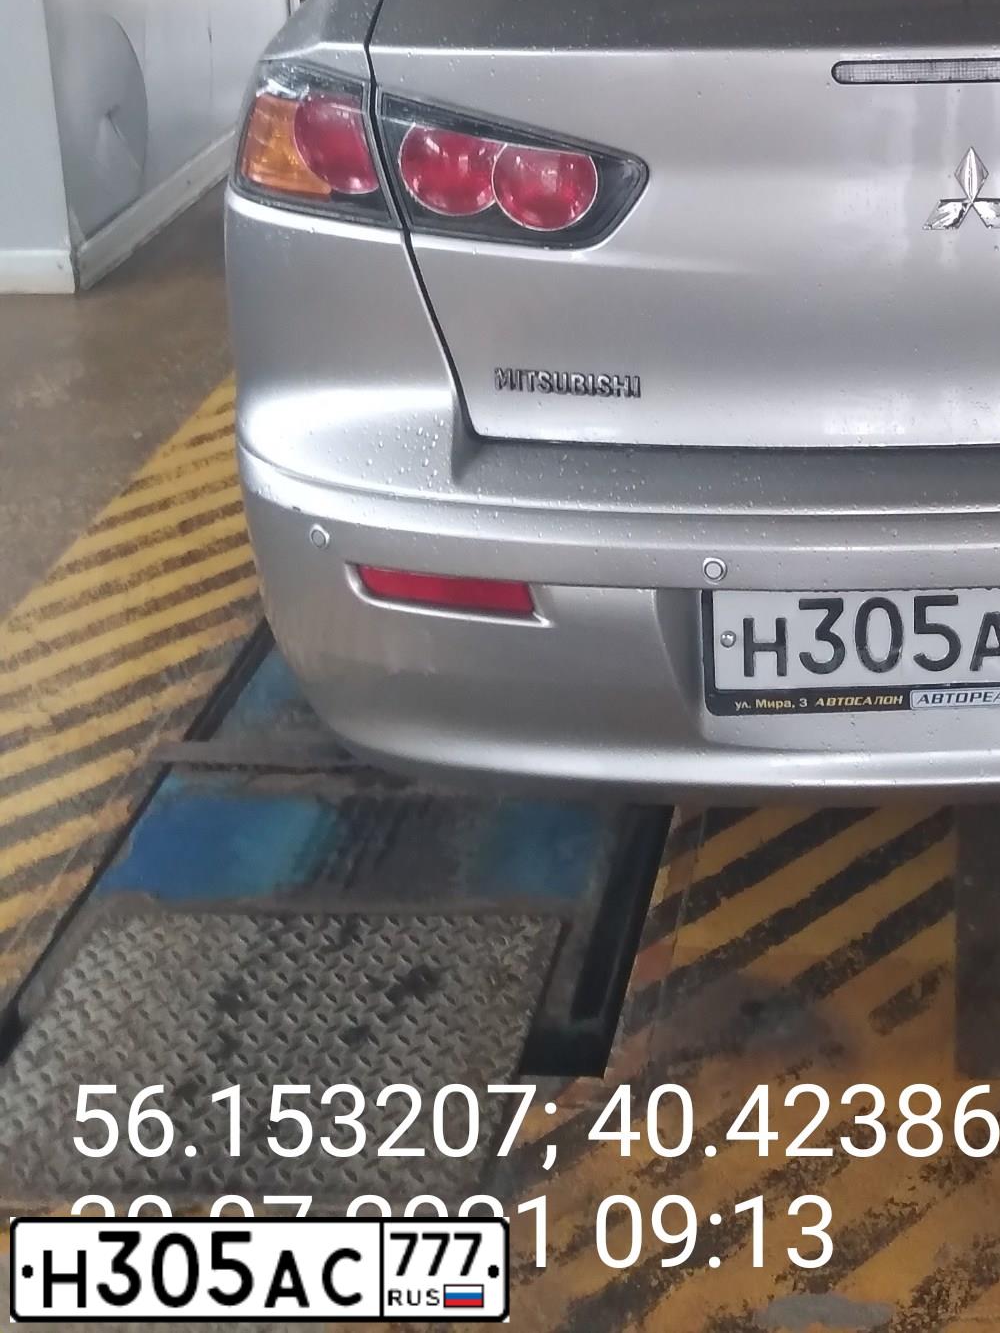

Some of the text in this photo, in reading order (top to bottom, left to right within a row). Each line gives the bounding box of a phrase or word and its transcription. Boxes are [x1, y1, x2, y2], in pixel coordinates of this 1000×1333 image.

[494, 367, 641, 398] MITSUBISHI
[799, 697, 808, 708] 3
[815, 695, 903, 707] АВТОСАЛОН
